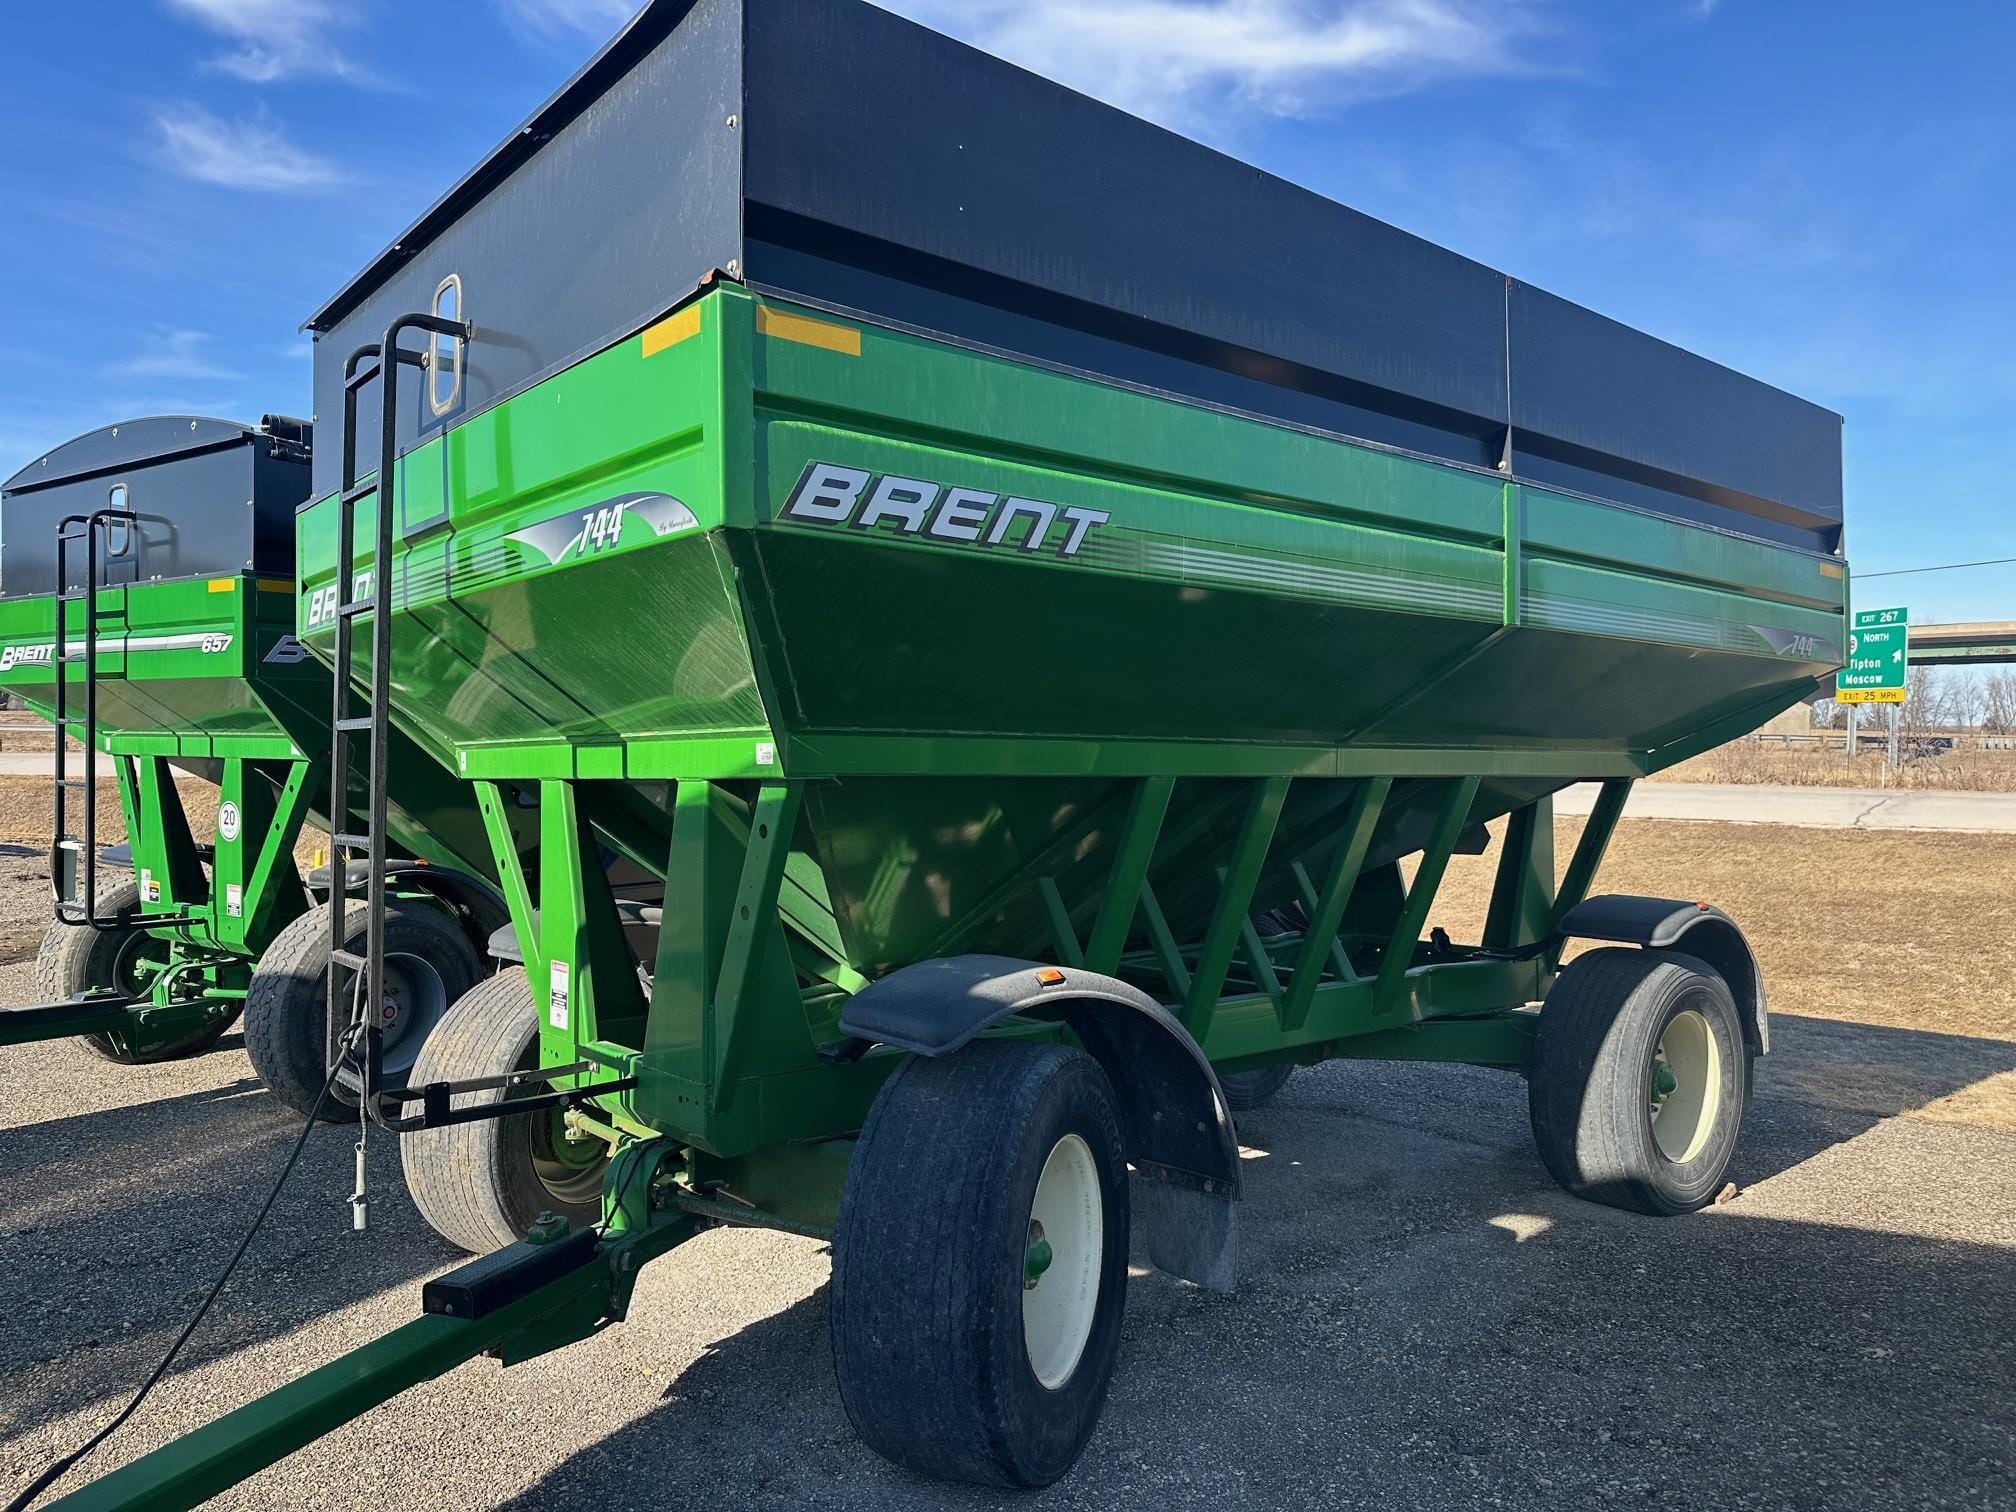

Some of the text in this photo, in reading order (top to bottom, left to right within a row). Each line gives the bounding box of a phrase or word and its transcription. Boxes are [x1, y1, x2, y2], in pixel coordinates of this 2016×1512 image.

[784, 462, 1111, 555] BRENT
[577, 503, 624, 553] 744
[1861, 611, 1898, 623] EXIT 267
[202, 635, 234, 654] 657
[1863, 633, 1889, 643] NORTH
[1791, 635, 1813, 656] 744
[1850, 658, 1881, 671] Tipton
[1845, 674, 1883, 685] Moscow
[1844, 691, 1897, 701] EXIT 25 MPH
[224, 810, 235, 825] 20
